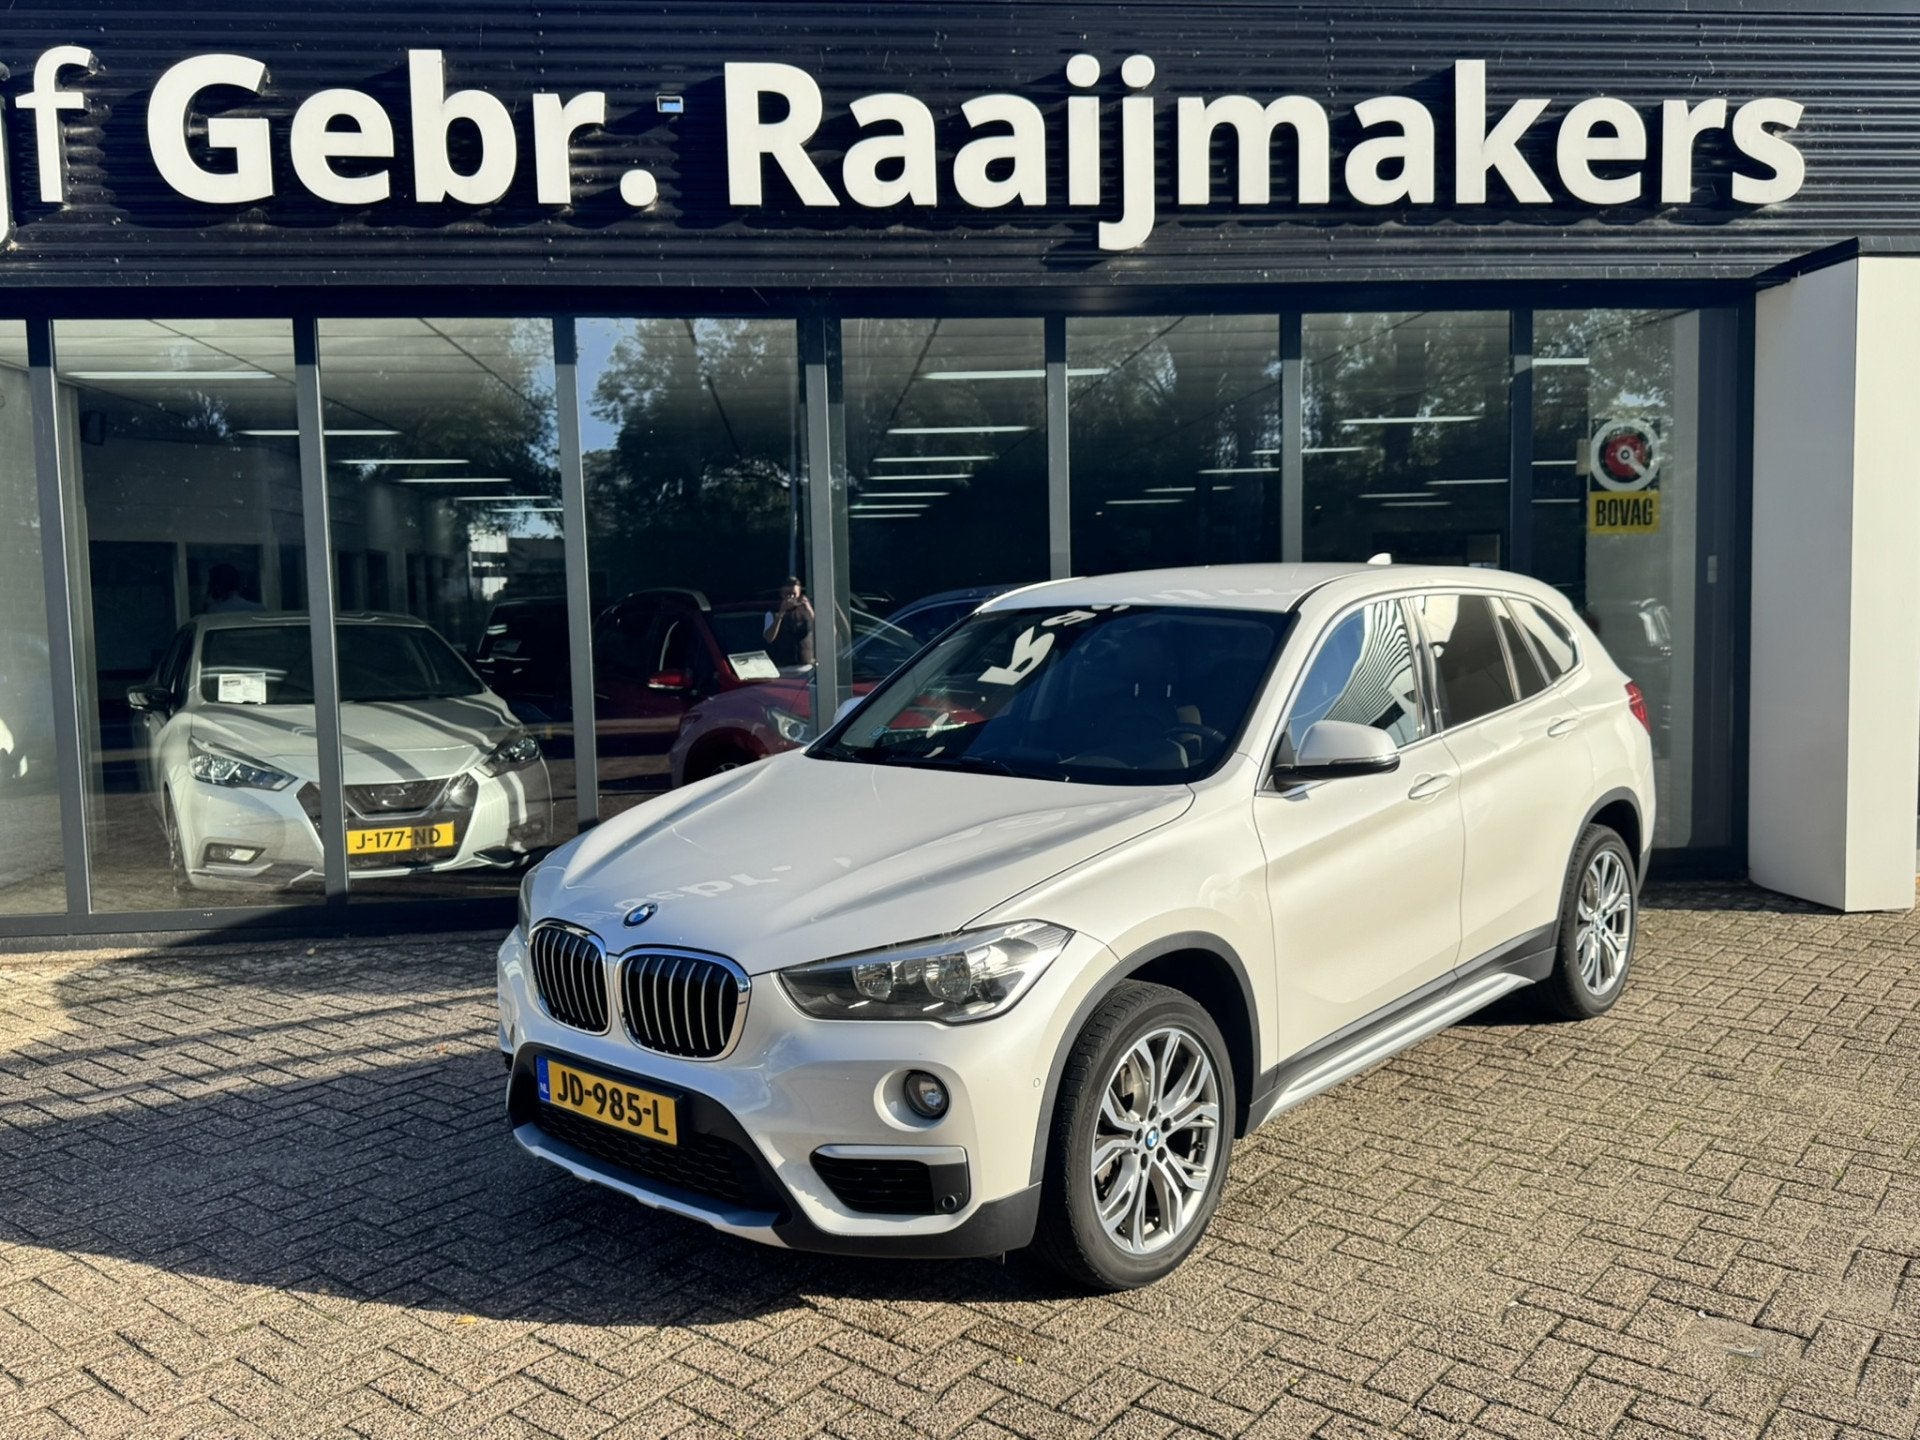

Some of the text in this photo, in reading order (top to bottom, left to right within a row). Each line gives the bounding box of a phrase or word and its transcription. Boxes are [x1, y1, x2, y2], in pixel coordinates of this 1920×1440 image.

[0, 45, 1806, 250] f Gebr. Raaijmakers
[1595, 498, 1653, 527] BOVAG
[355, 827, 441, 850] J-177-ND
[557, 1070, 669, 1136] JD-985-L
